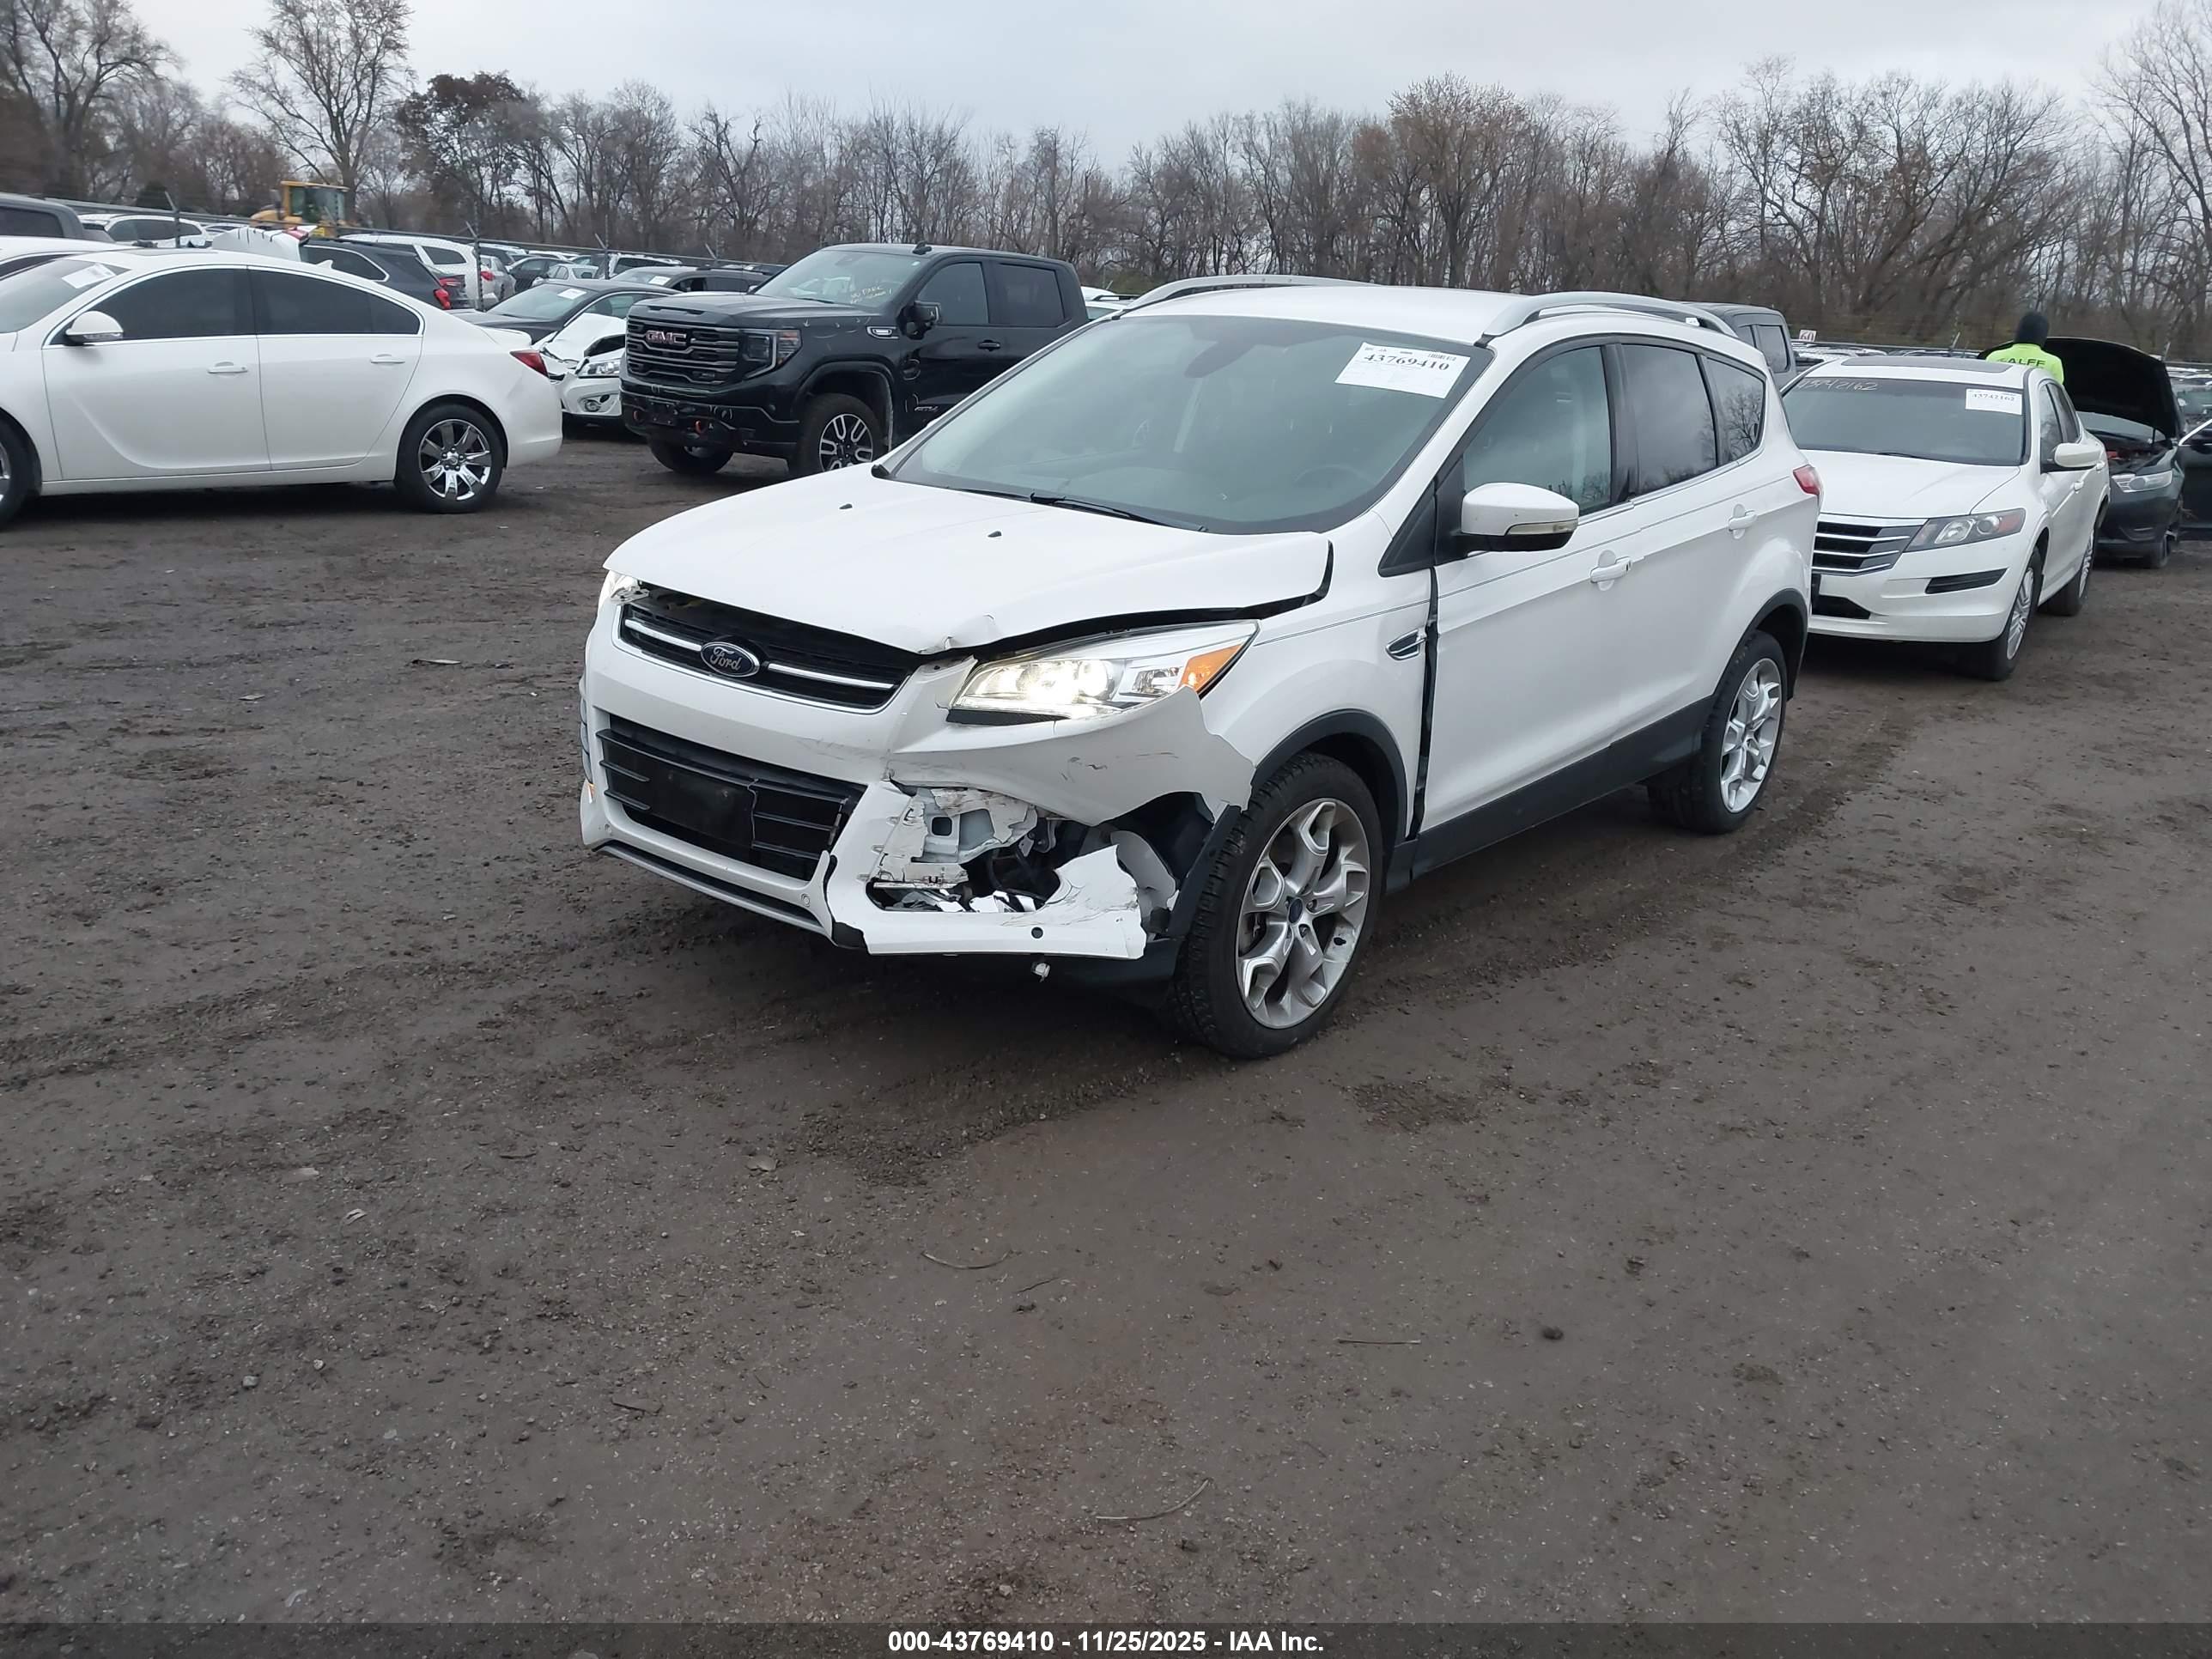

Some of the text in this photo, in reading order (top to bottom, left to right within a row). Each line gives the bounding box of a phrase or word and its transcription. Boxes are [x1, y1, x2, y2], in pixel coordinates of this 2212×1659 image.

[645, 330, 687, 345] GMC
[1364, 354, 1450, 371] 43769410
[710, 646, 742, 671] Ford
